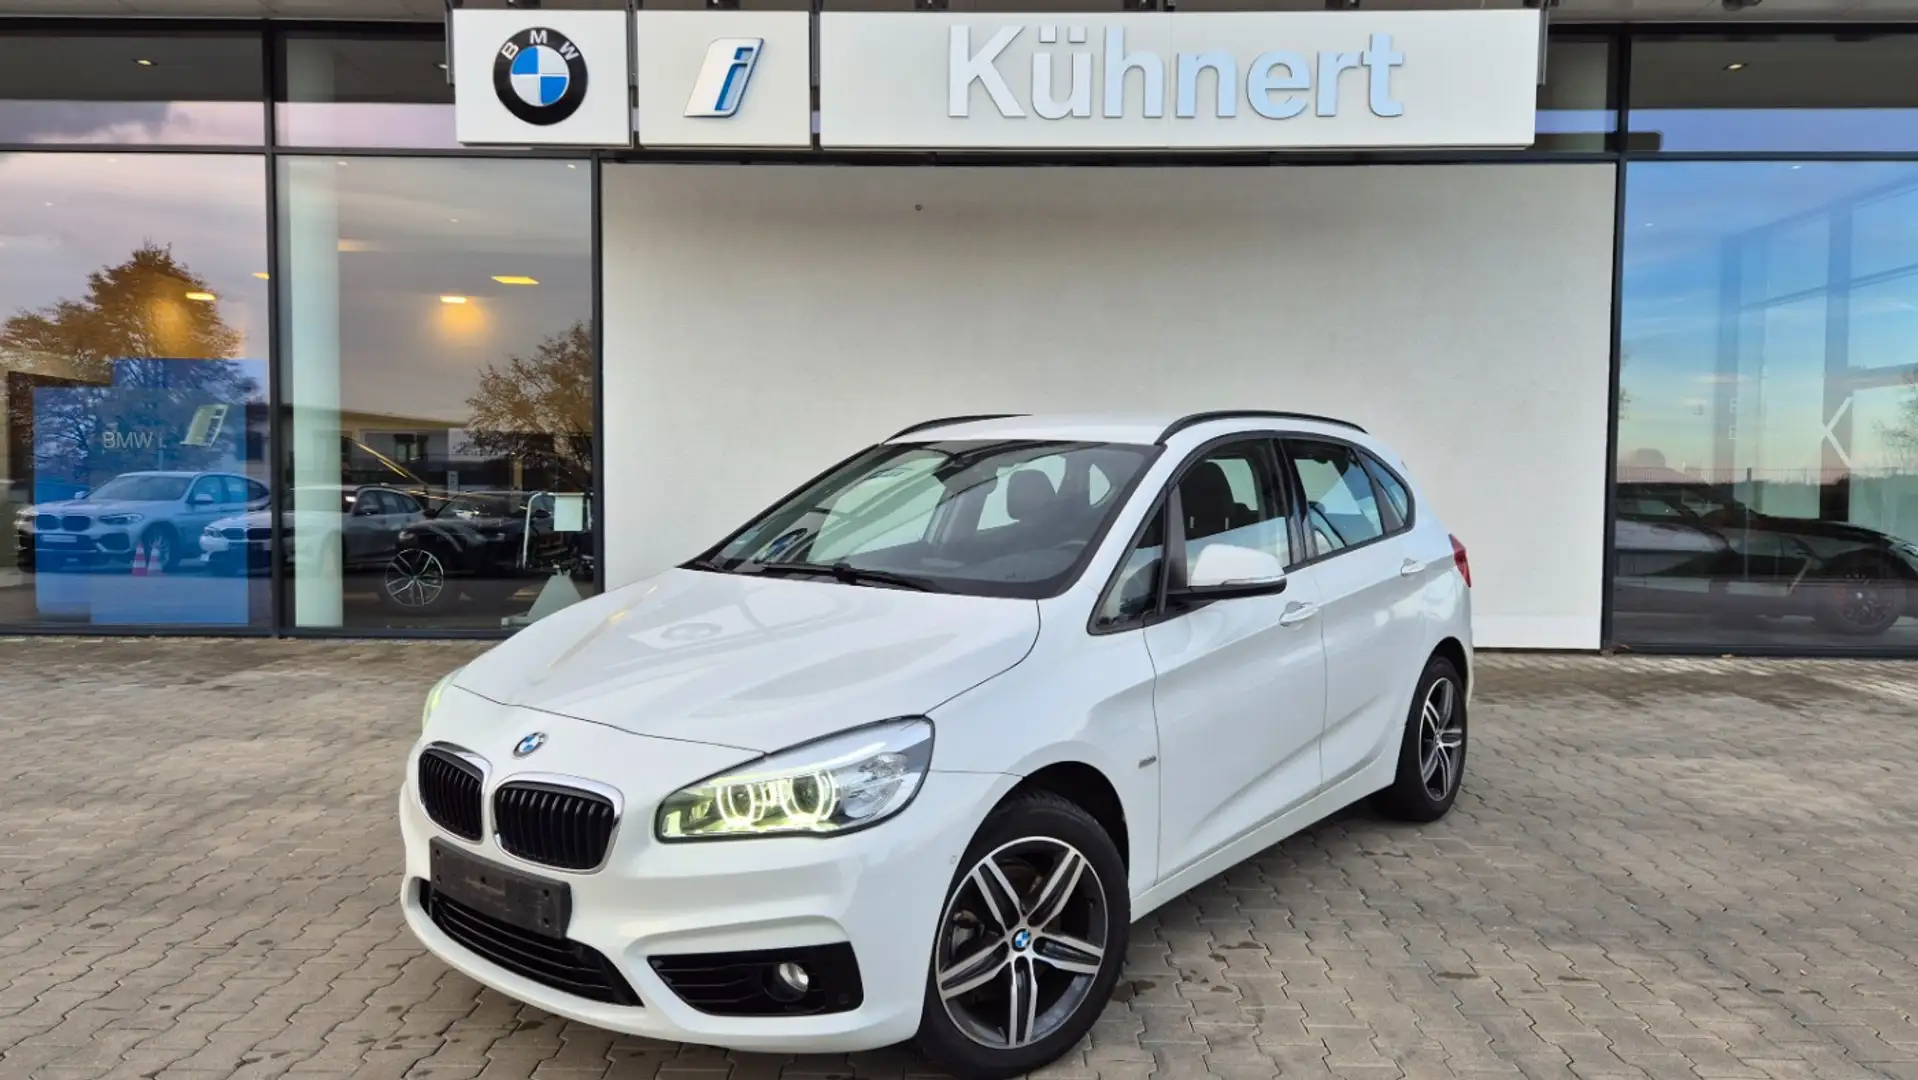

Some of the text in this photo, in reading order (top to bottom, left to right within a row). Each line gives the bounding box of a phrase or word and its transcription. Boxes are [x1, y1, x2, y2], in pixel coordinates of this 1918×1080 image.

[501, 29, 580, 61] BMW
[947, 24, 1405, 120] Kühnert
[102, 431, 153, 449] BMW
